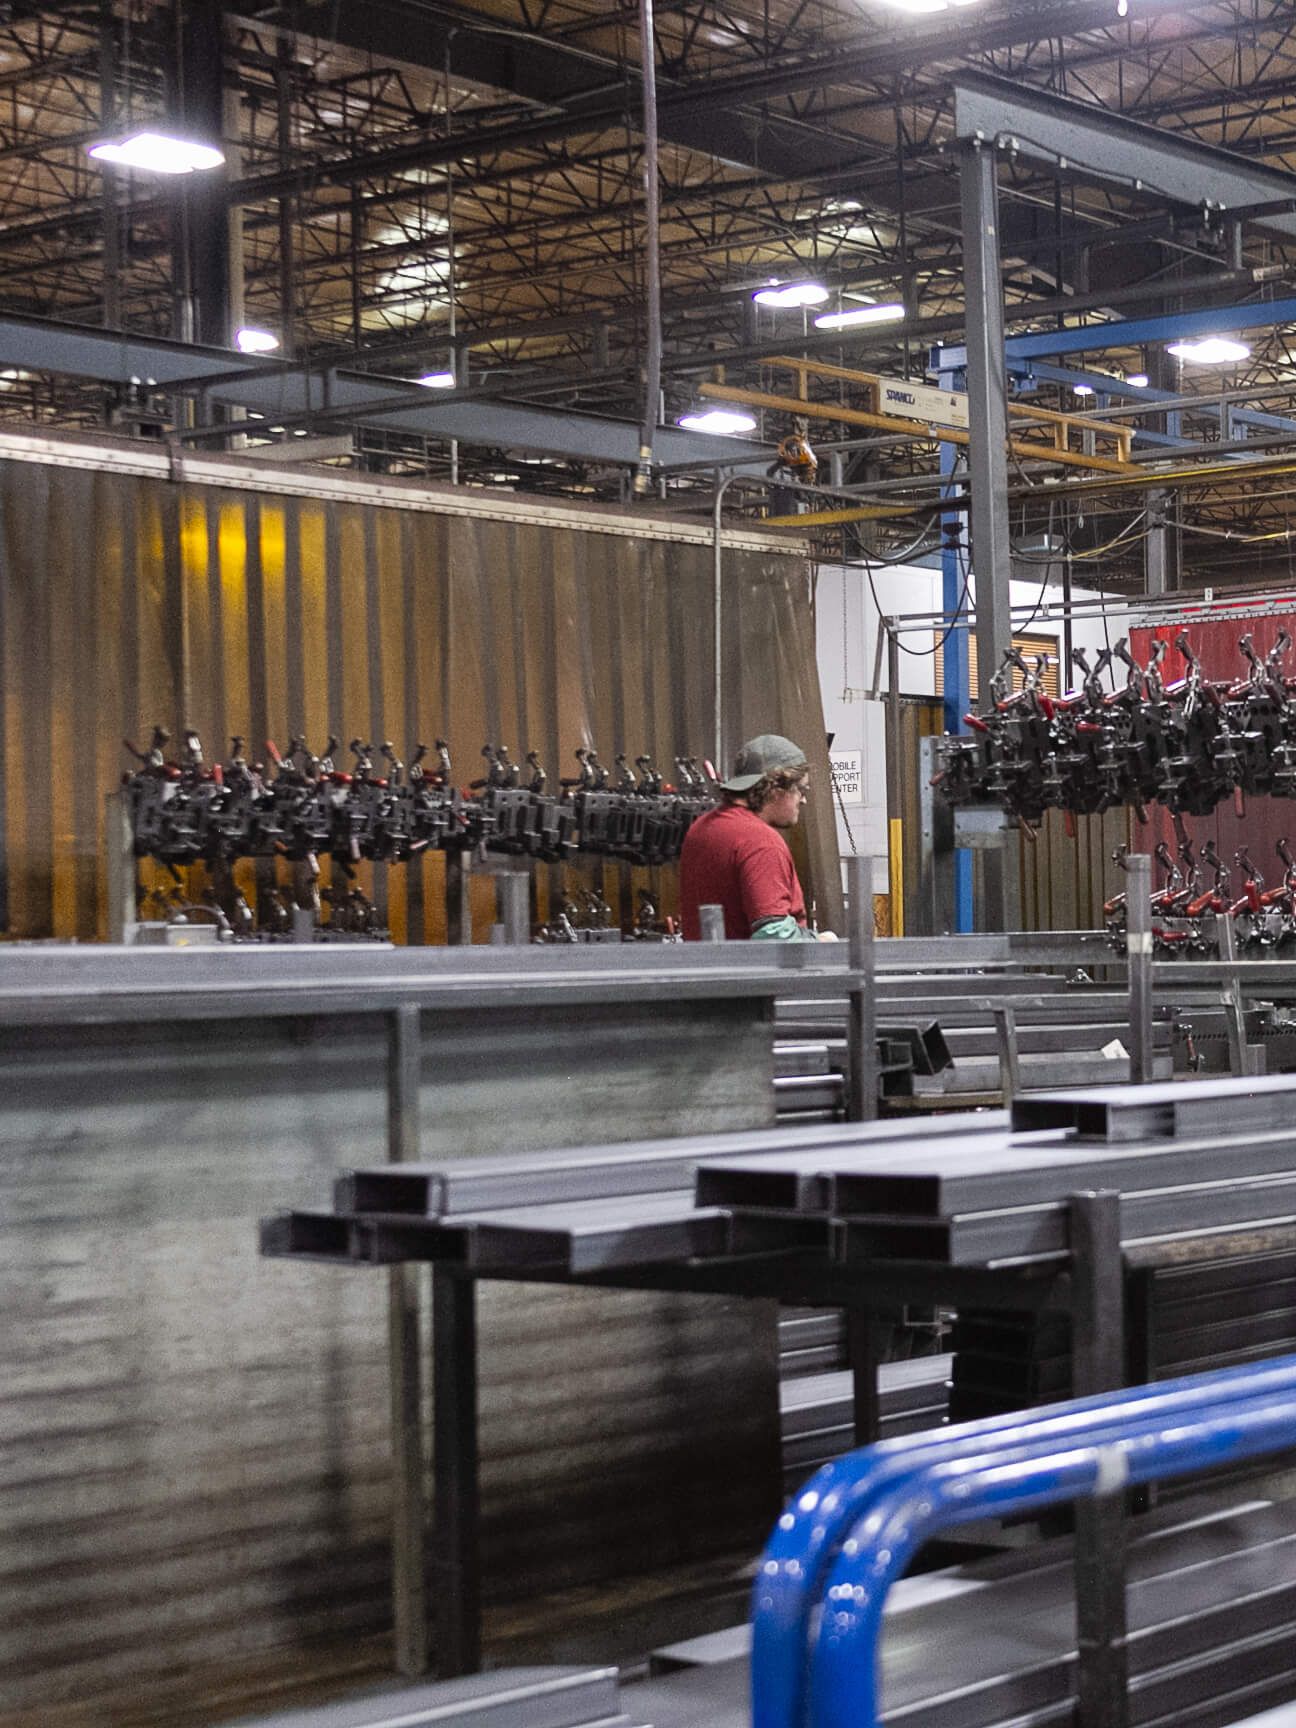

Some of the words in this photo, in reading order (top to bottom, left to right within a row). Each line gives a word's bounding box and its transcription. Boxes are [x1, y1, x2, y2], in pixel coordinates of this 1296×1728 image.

[832, 761, 857, 770] OBILE
[832, 772, 860, 782] PPORT
[832, 784, 858, 793] ENTER
